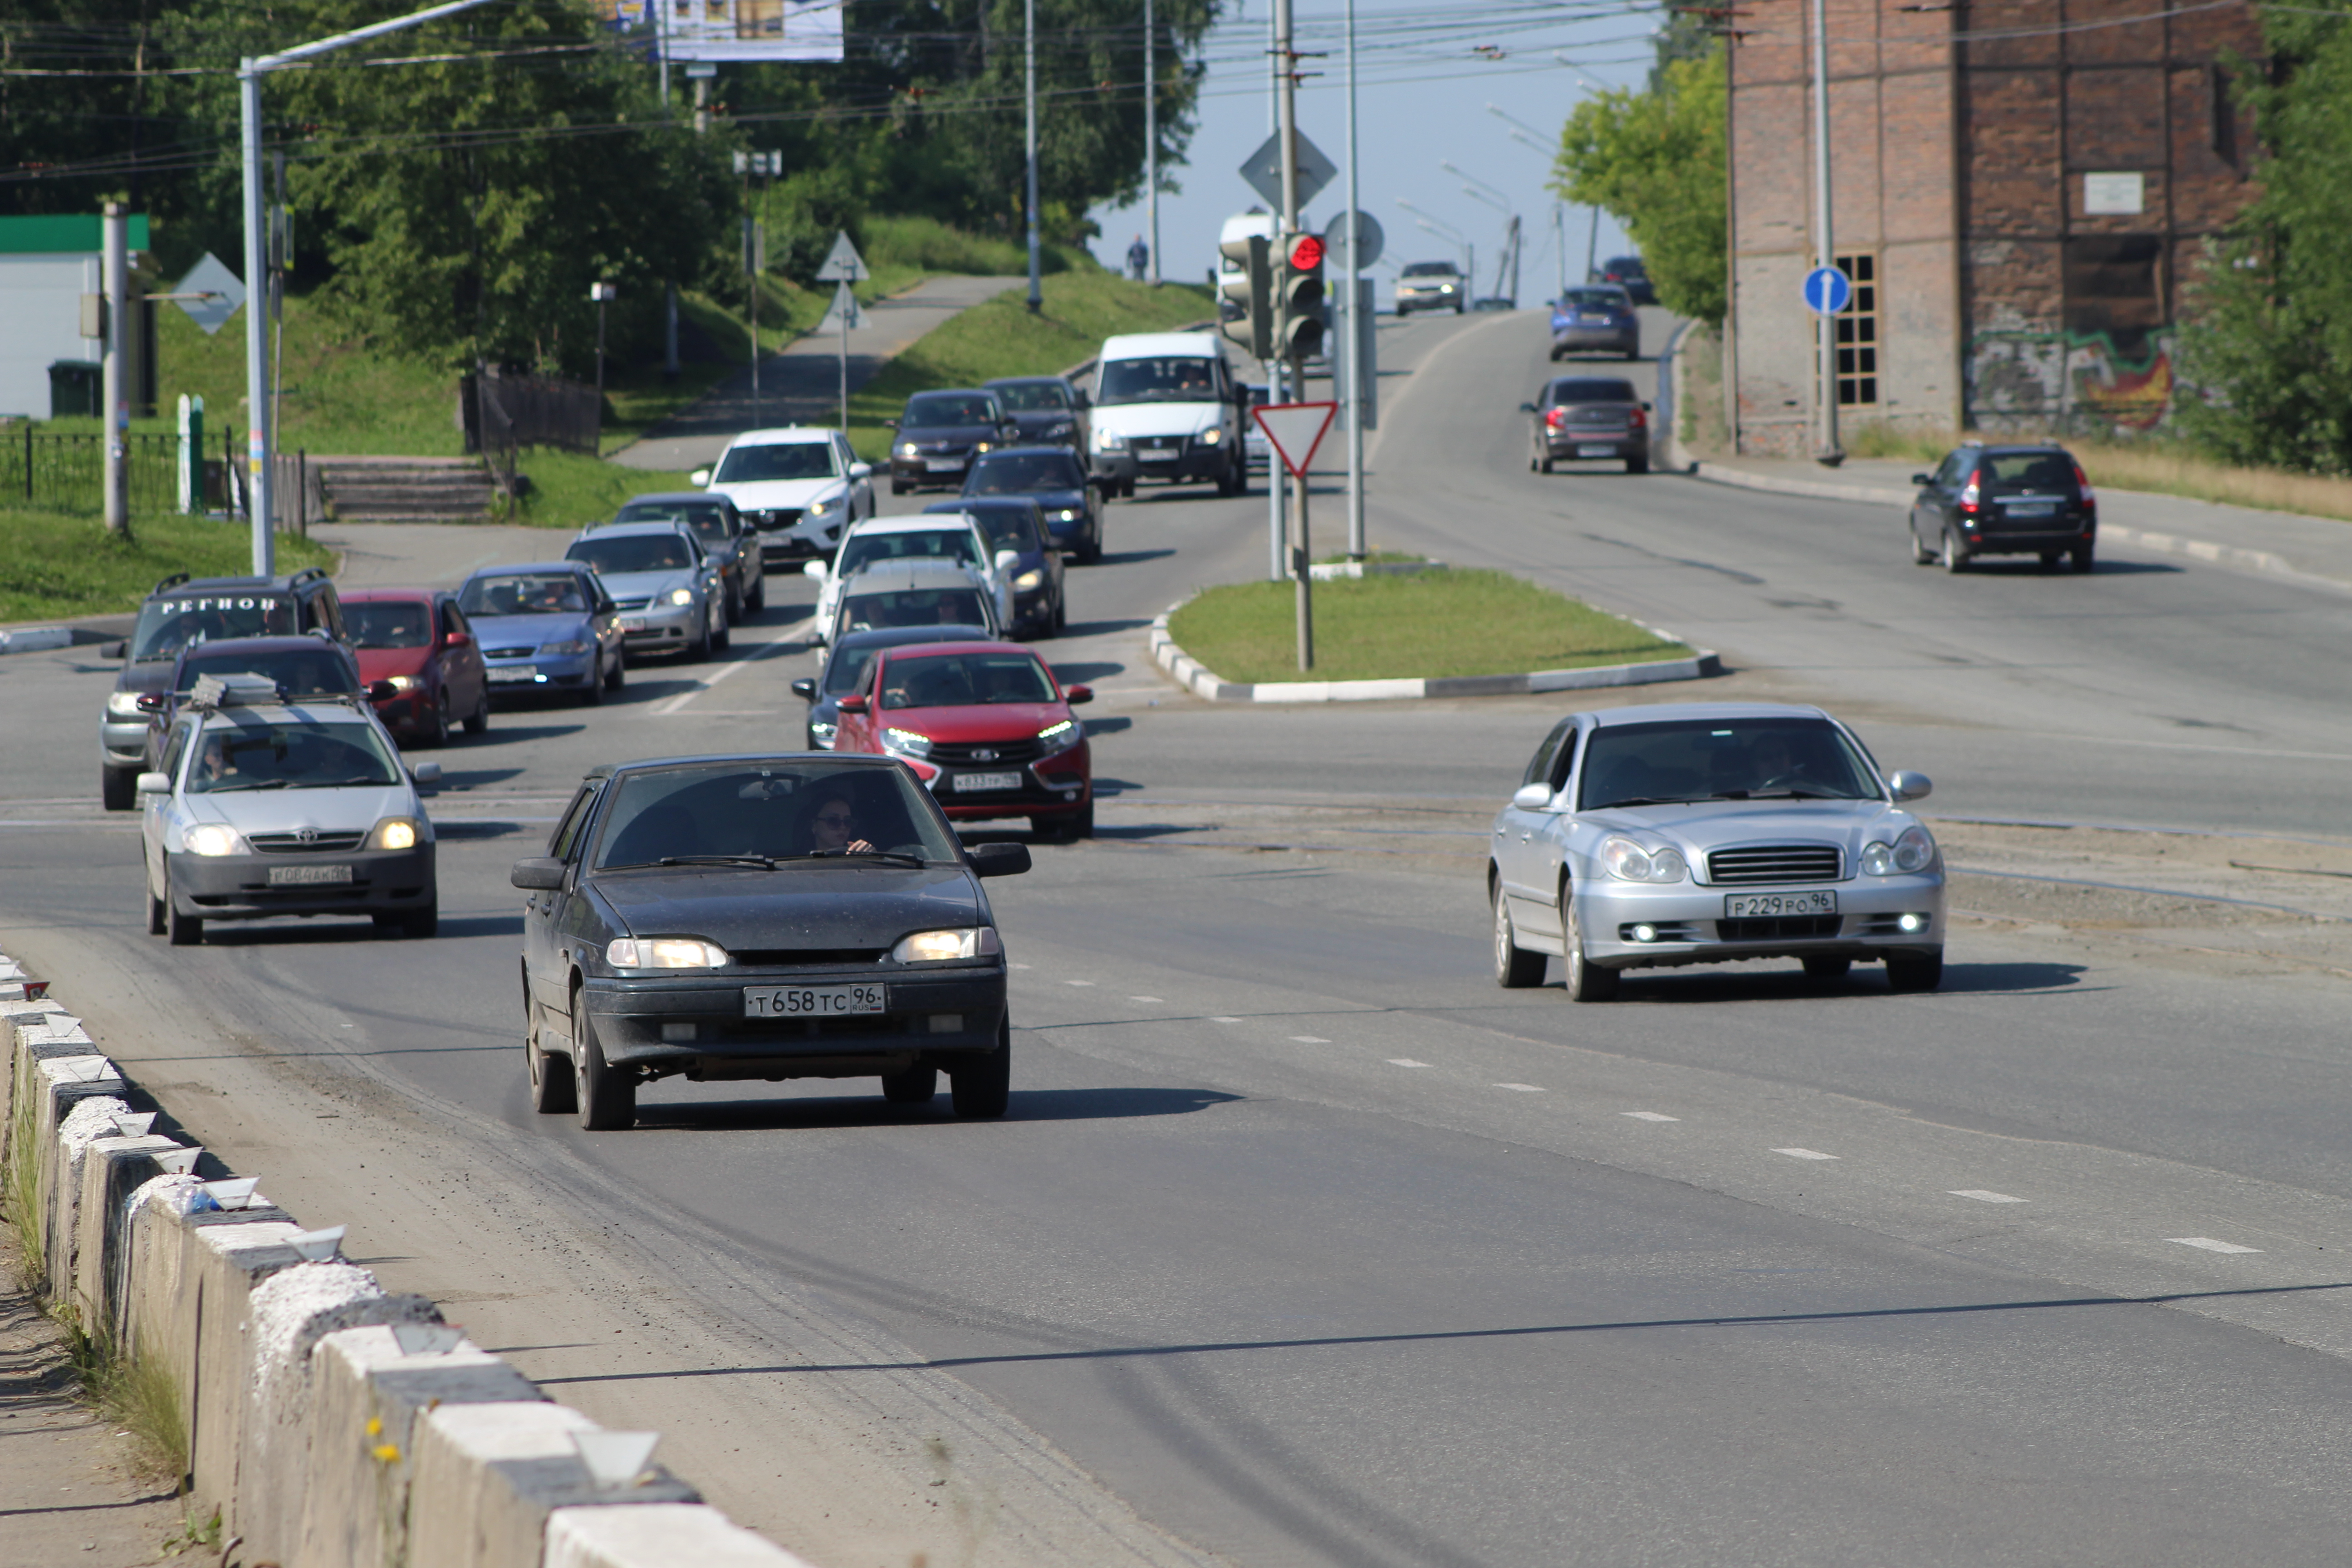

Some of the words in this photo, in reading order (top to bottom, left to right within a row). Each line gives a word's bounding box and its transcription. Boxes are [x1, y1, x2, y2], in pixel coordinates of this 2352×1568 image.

[162, 597, 275, 615] РЕГИОН
[1734, 896, 1807, 915] Р229РО
[1811, 893, 1829, 906] 96
[755, 990, 846, 1013] Т658ТС
[853, 987, 876, 1004] 96
